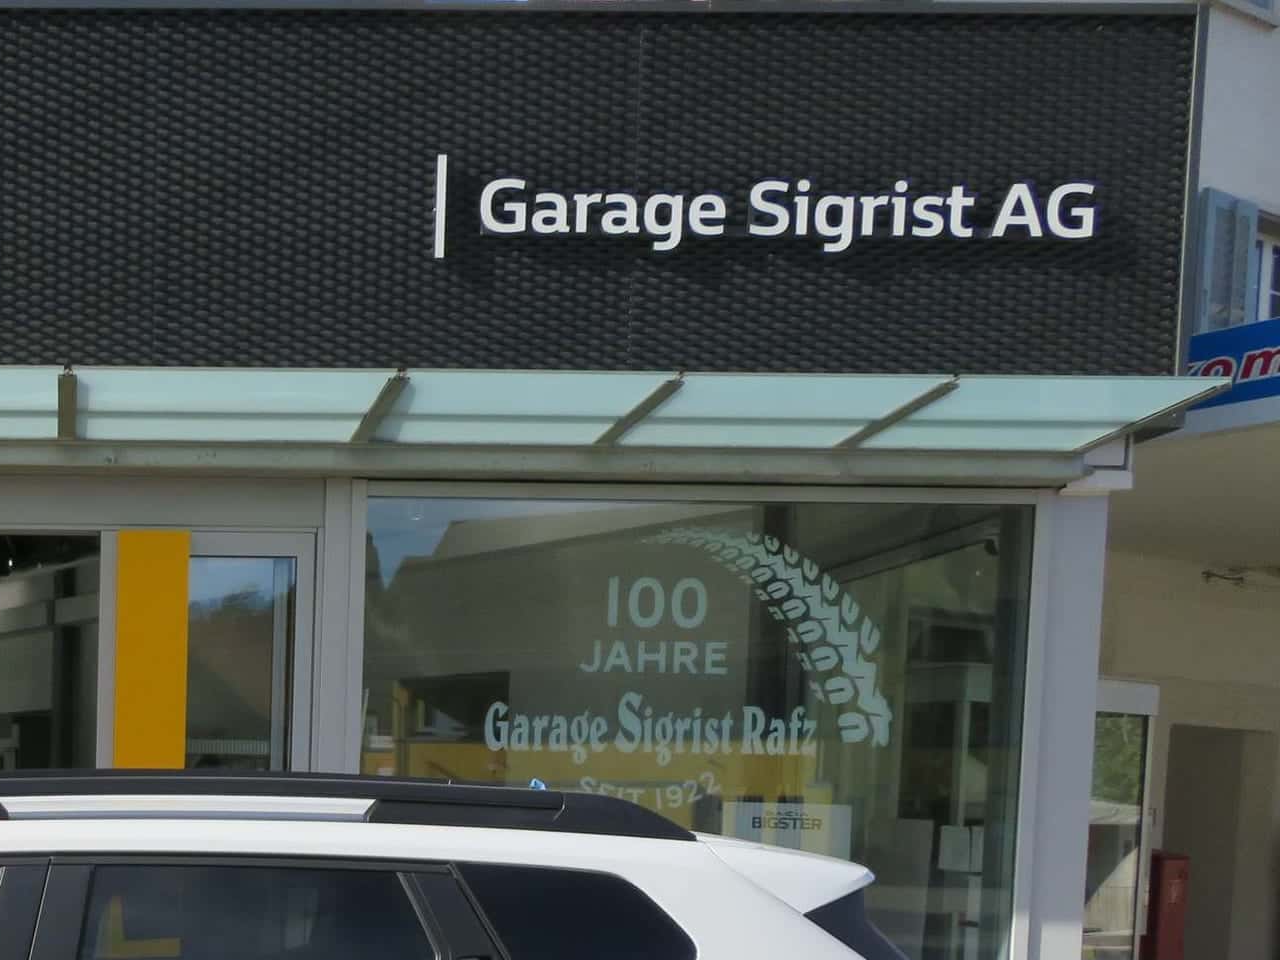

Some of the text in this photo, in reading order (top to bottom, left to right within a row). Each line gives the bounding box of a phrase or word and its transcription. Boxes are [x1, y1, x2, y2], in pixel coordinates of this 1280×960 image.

[479, 178, 1097, 252] Garage Sigrist AG
[607, 576, 709, 629] 100
[579, 640, 729, 675] JAHRE
[484, 691, 818, 766] Garage Sigrist Rafz
[655, 771, 723, 811] 1922
[751, 816, 823, 830] BIGSTER
